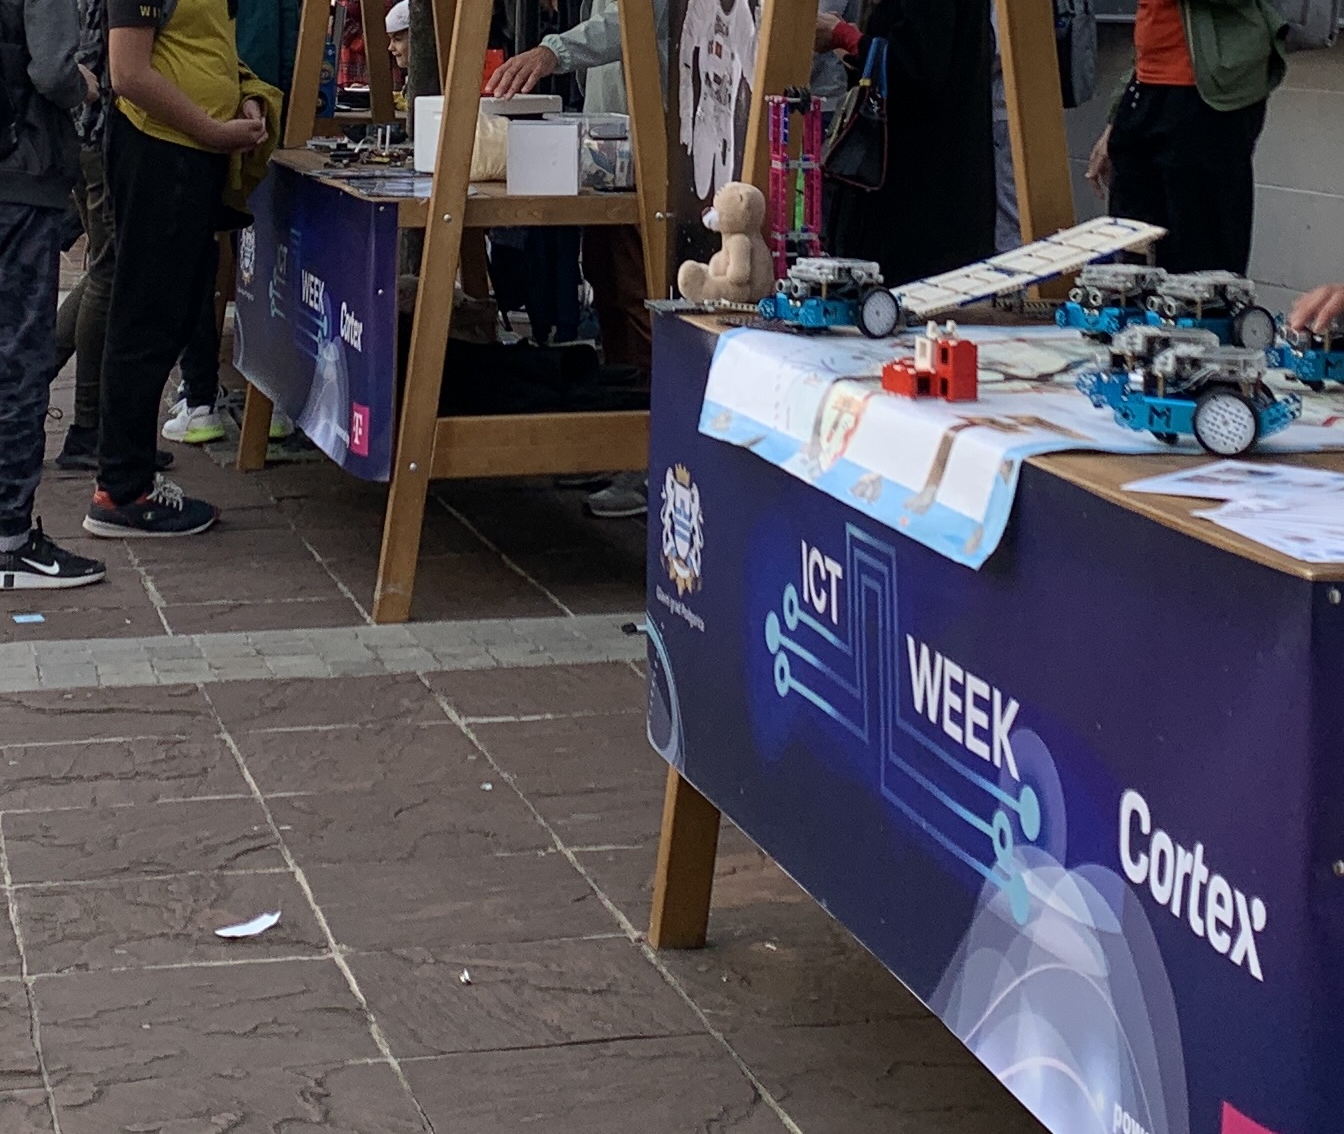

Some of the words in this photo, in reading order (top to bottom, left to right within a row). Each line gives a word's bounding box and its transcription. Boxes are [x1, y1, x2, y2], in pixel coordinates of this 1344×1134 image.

[301, 269, 325, 316] WEEK
[340, 301, 363, 353] Cortex
[801, 539, 843, 625] ICT
[906, 633, 1021, 782] WEEK
[1119, 788, 1267, 982] Cortex
